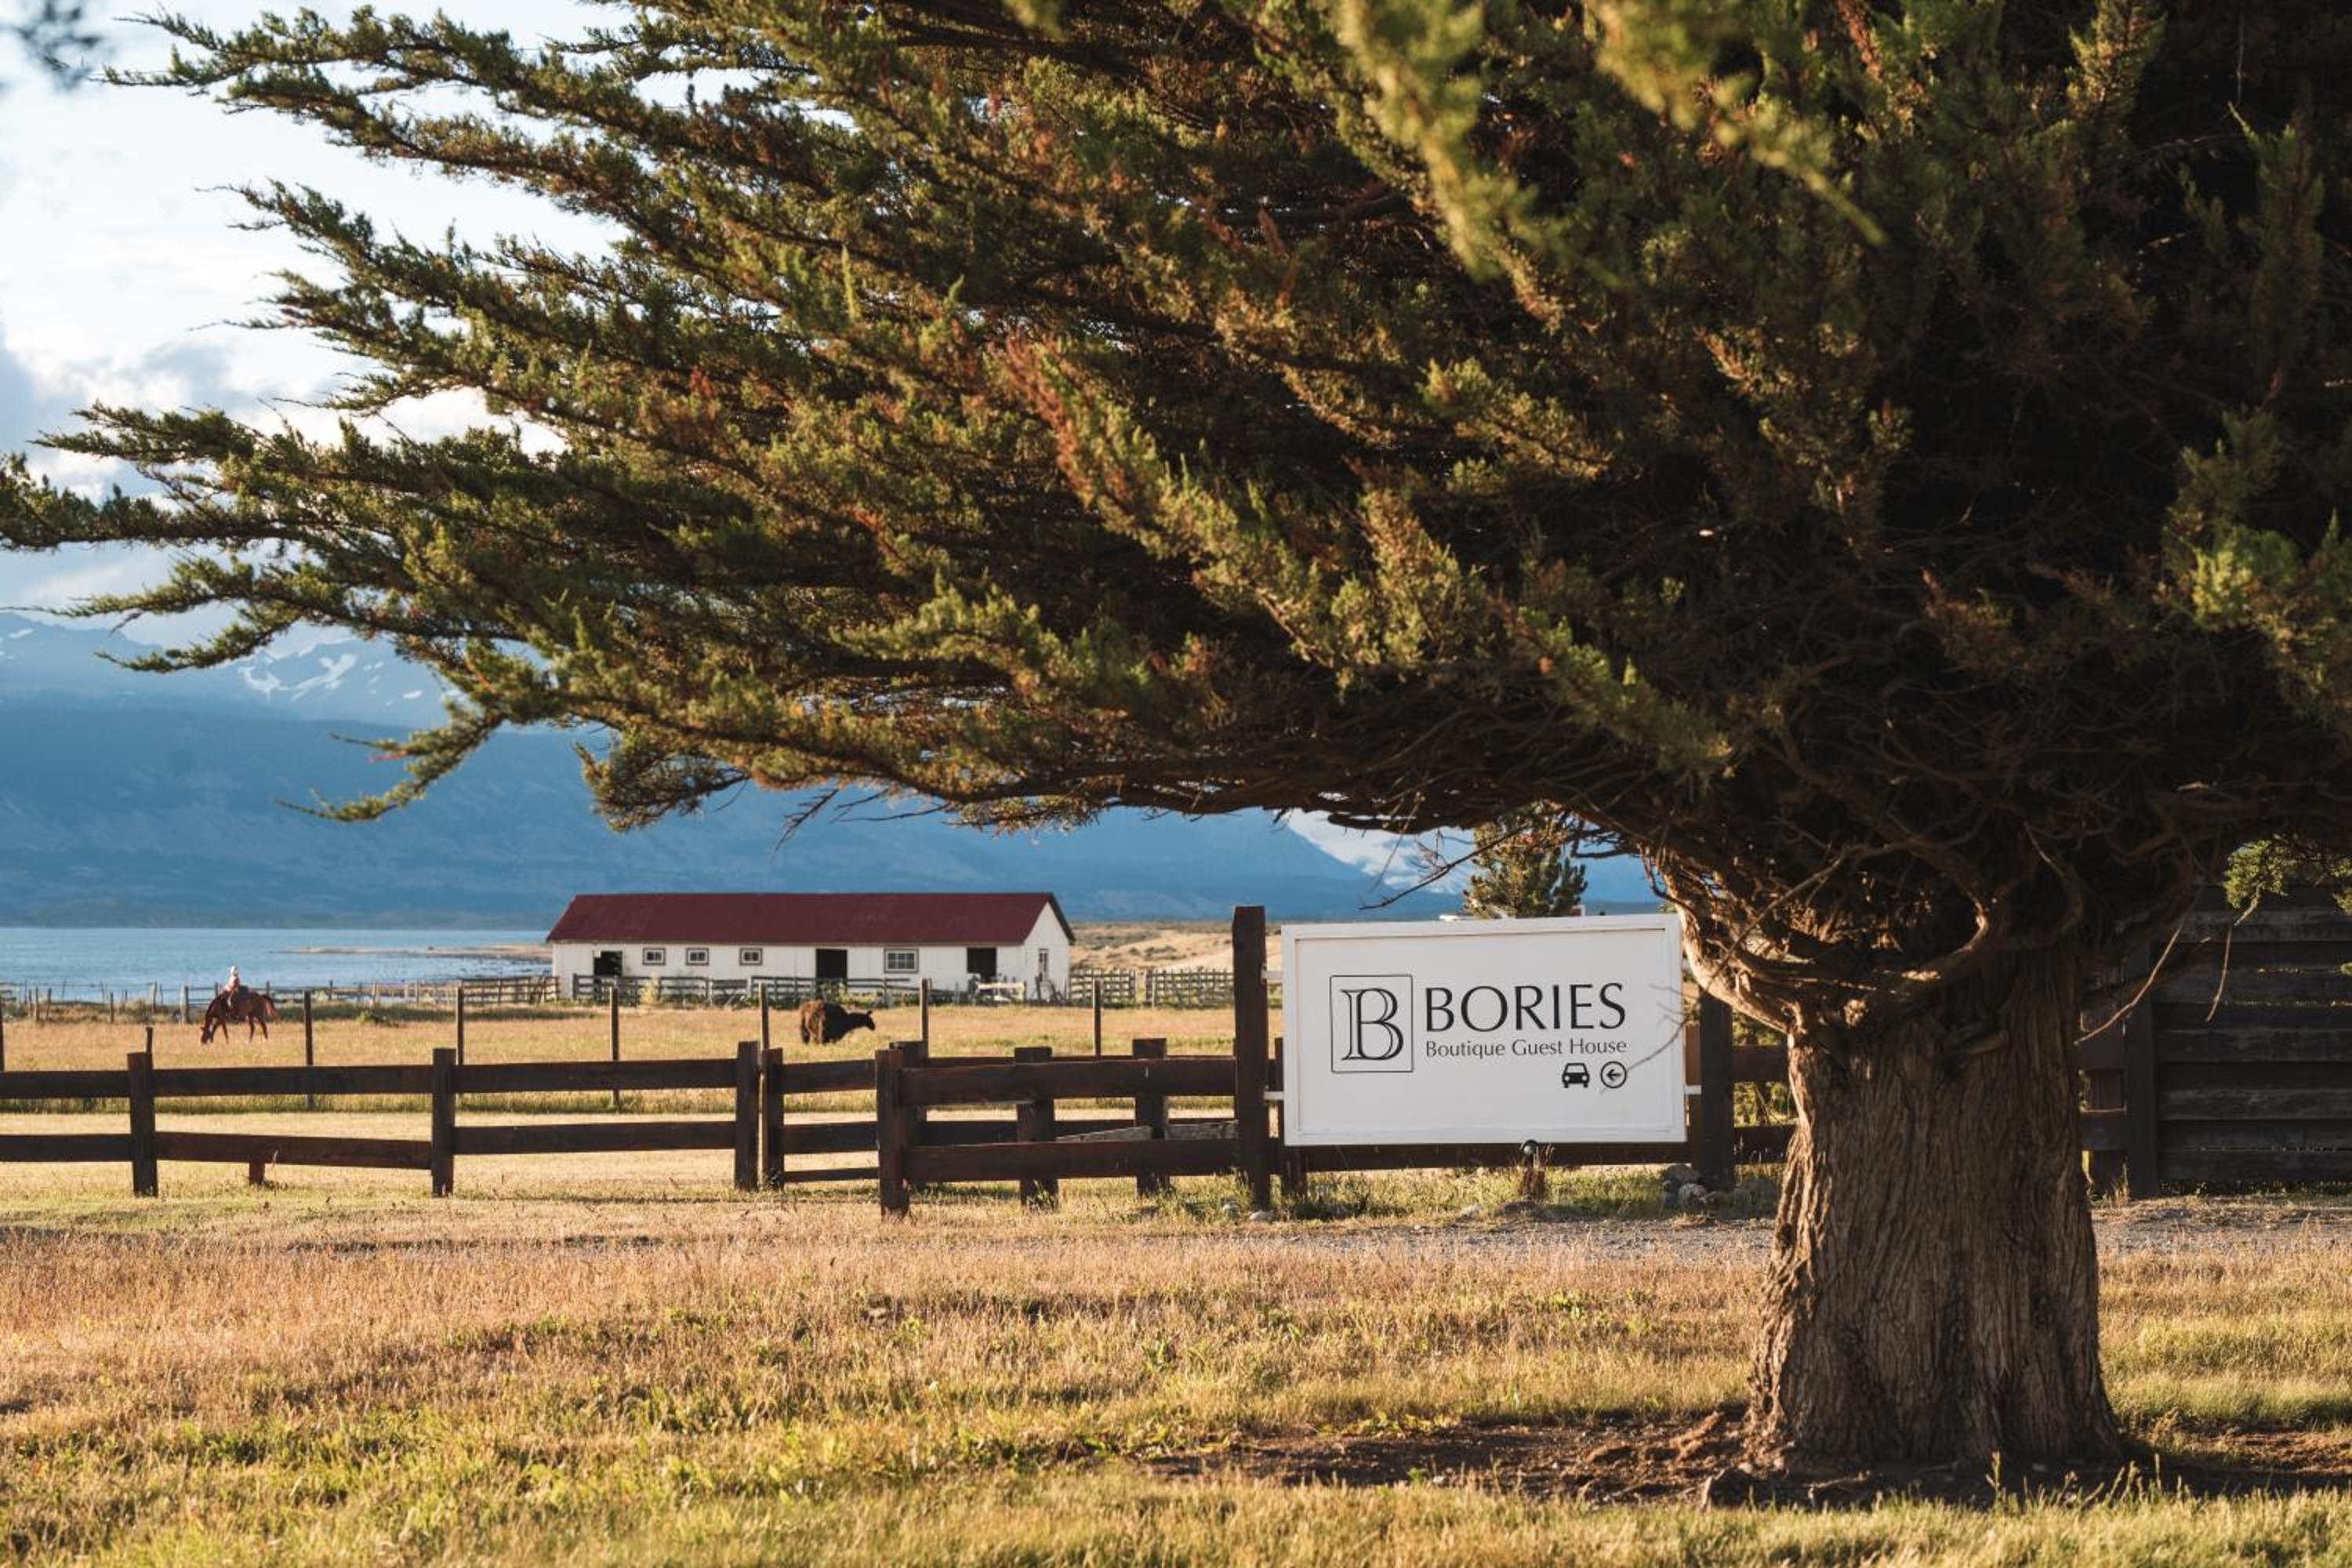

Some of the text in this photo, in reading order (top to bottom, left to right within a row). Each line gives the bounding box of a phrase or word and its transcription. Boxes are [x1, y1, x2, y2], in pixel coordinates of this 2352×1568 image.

[1339, 988, 1404, 1061] B
[1425, 982, 1626, 1033] BORIES
[1425, 1038, 1627, 1059] Boutique Guest House
